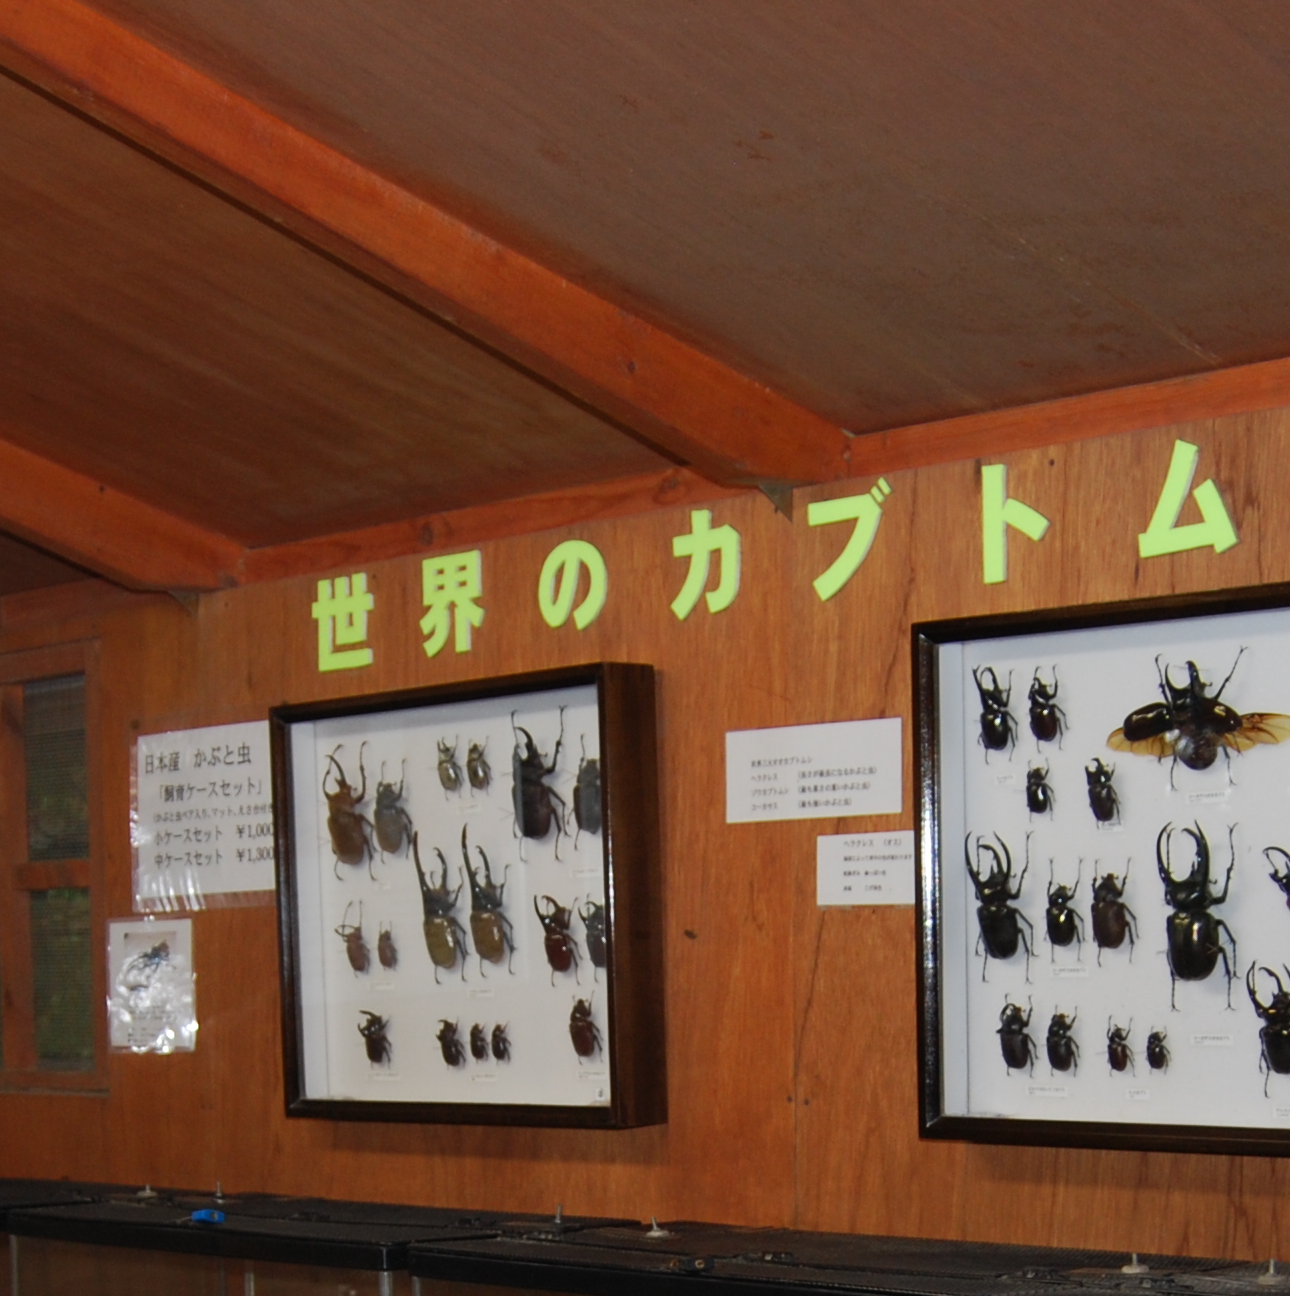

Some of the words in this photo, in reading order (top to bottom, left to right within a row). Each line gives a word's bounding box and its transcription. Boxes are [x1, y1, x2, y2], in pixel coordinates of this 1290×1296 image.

[145, 751, 180, 774] 日本産
[194, 742, 251, 769] かぶと虫
[159, 777, 262, 803] 「飼育ケースセット」
[155, 825, 223, 846] 小ケースセット
[154, 848, 223, 868] 中ケースセット
